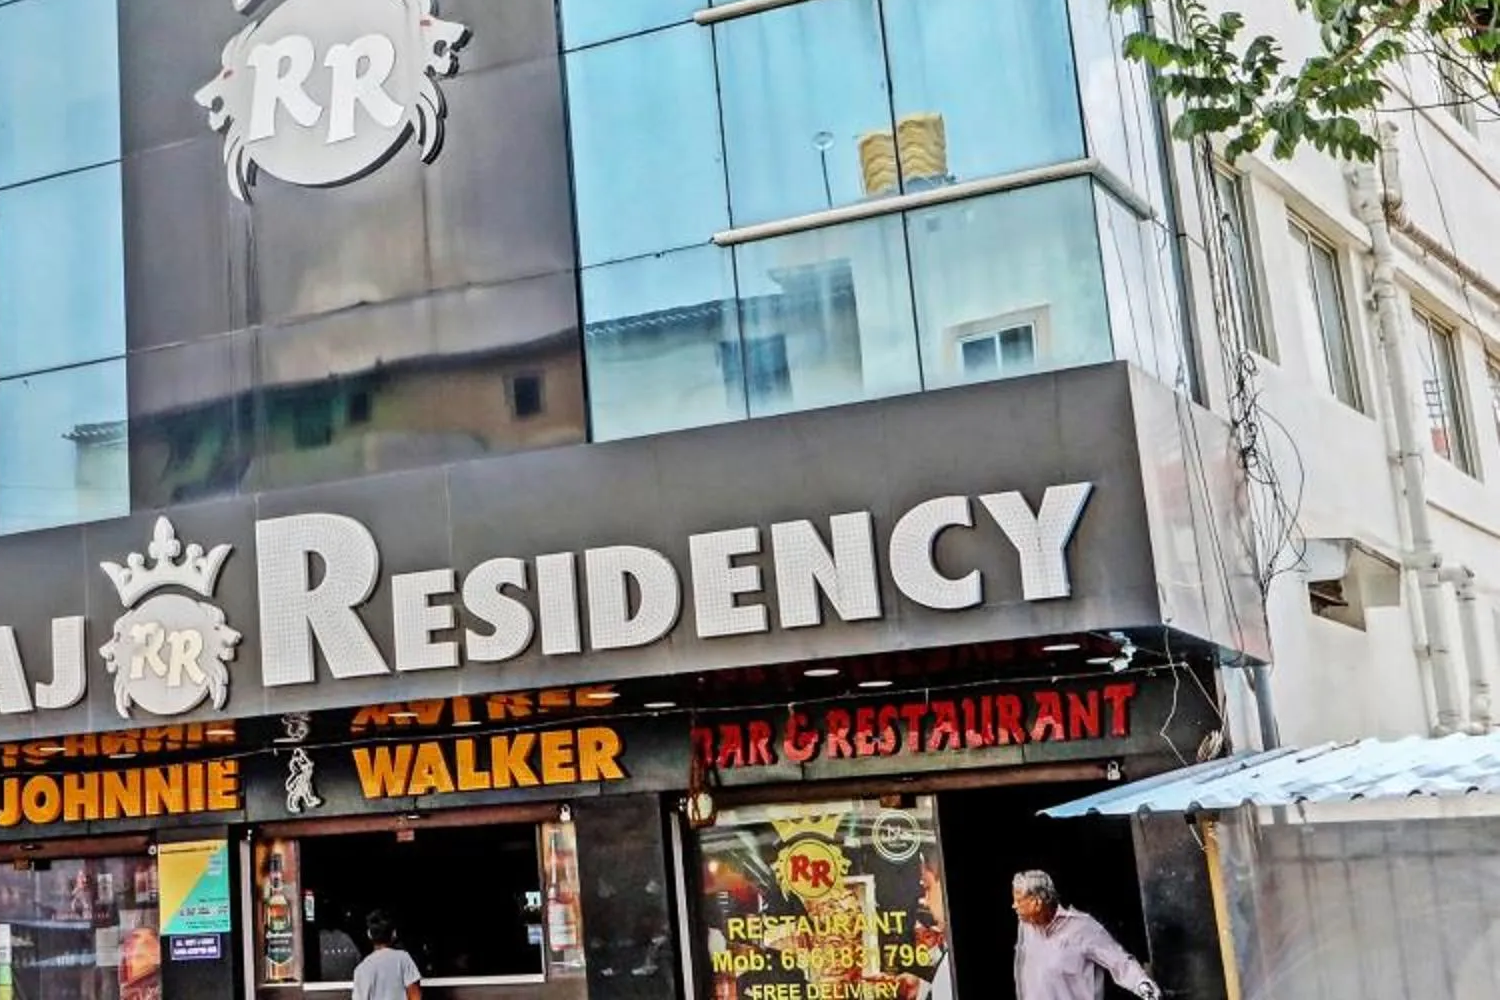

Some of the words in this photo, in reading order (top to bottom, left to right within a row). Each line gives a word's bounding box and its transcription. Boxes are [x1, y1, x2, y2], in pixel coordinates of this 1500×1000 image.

[246, 33, 405, 144] RR
[255, 481, 1095, 688] RESIDENCY
[128, 621, 207, 688] RR
[783, 710, 820, 763] &
[827, 683, 1136, 760] RESTAURANT
[351, 727, 627, 800] WALKER
[789, 854, 836, 889] RR
[726, 911, 908, 941] RESTAURANT
[711, 948, 772, 973] Mob:
[751, 984, 800, 1000] FREE
[807, 981, 900, 999] DELIVERY
